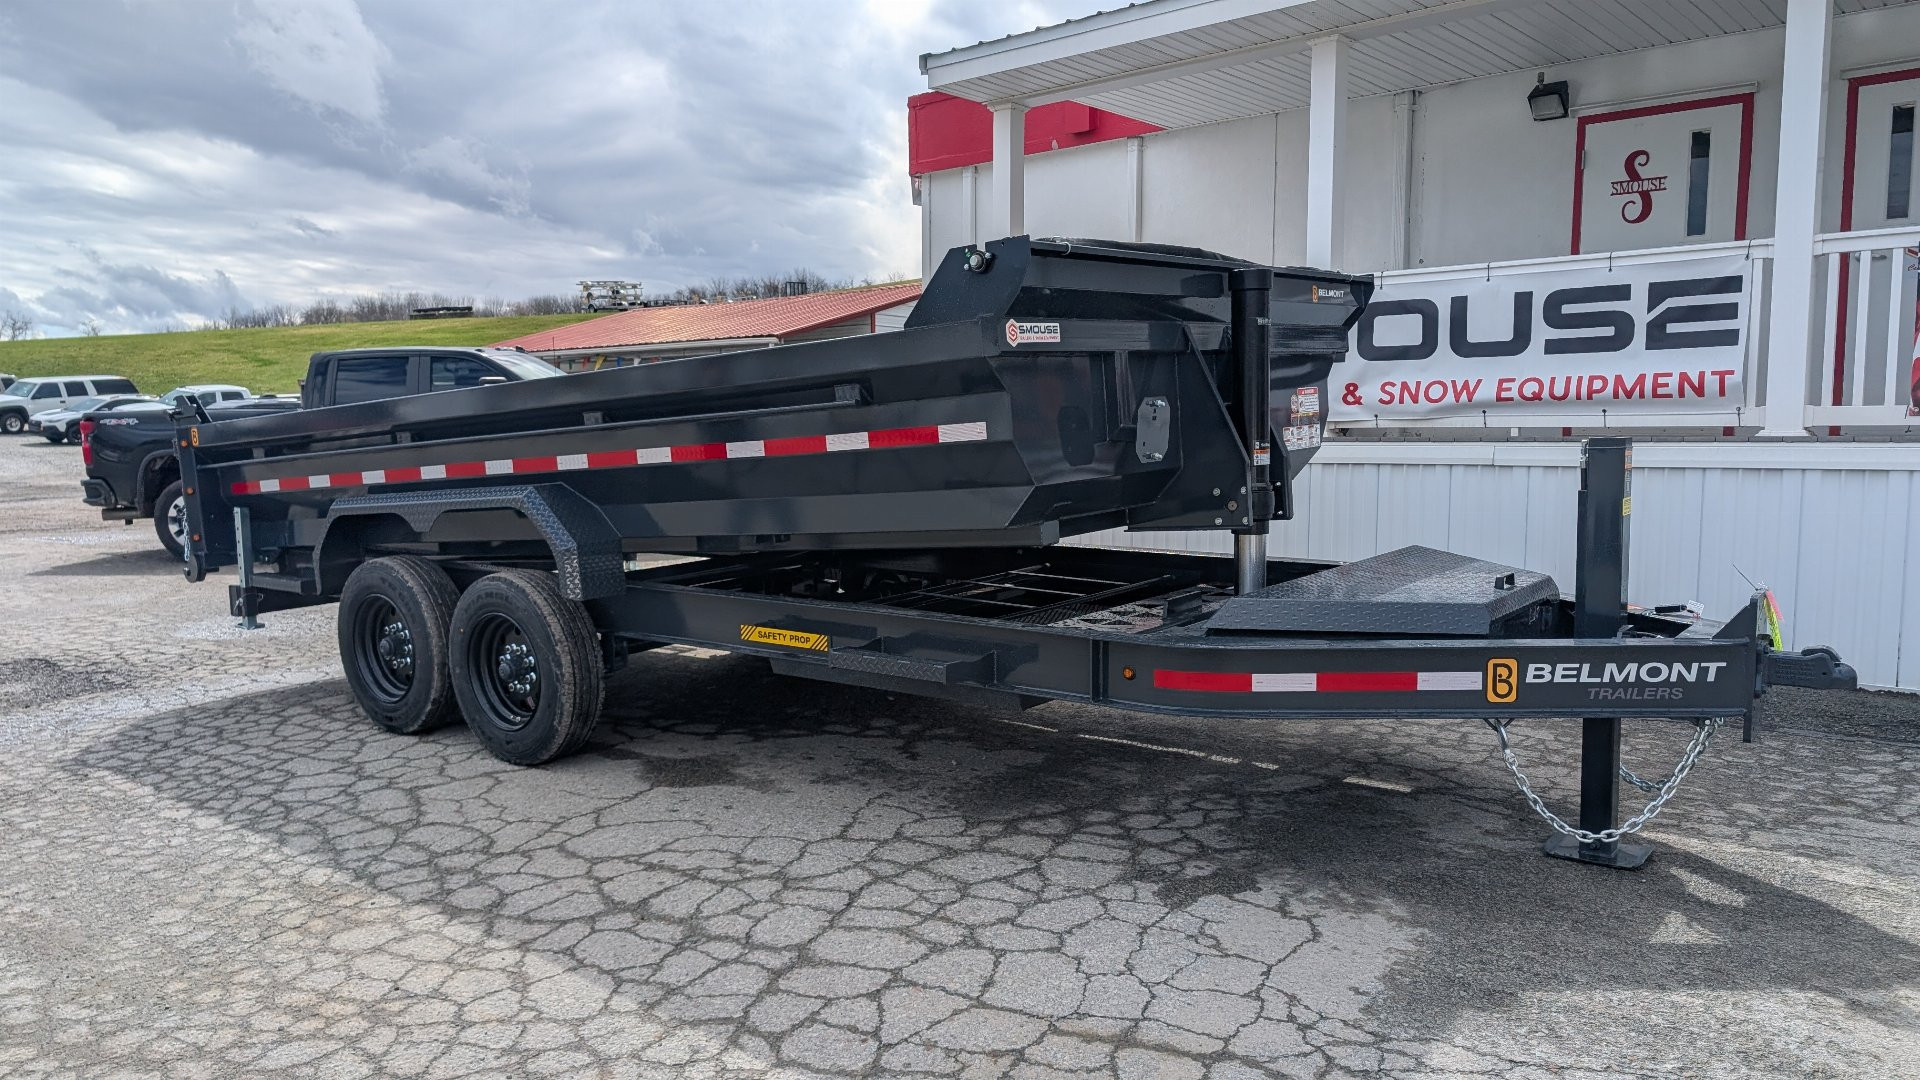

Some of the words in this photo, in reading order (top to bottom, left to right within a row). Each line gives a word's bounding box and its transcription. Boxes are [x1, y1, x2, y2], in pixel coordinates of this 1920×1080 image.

[1611, 178, 1666, 195] SMOUSE
[1318, 289, 1345, 298] BELMONT
[1334, 274, 1743, 362] OUSE
[1019, 325, 1059, 334] SMOUSE
[1341, 382, 1364, 406] &
[1379, 378, 1483, 406] SNOW
[1495, 369, 1736, 402] EQUIPMENT
[757, 630, 788, 642] SAFETY
[789, 634, 811, 645] PROP
[1525, 661, 1727, 683] BELMONT
[1587, 687, 1684, 700] TRAILERS
